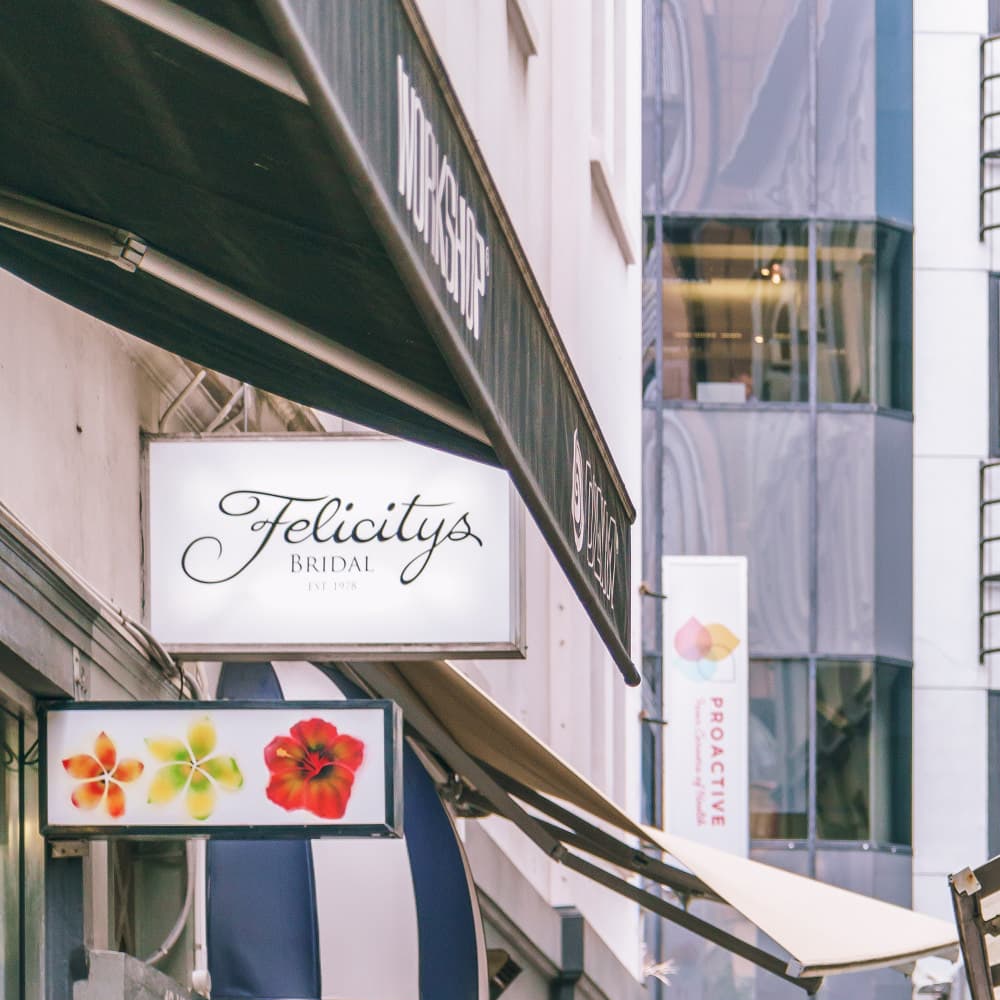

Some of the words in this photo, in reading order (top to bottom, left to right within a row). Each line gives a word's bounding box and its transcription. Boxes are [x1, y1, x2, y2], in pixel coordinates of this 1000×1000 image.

[397, 54, 485, 341] WORKSHOP
[181, 490, 484, 586] Felicitys
[291, 553, 375, 574] BRIDAL
[711, 697, 725, 827] PROACTIVE
